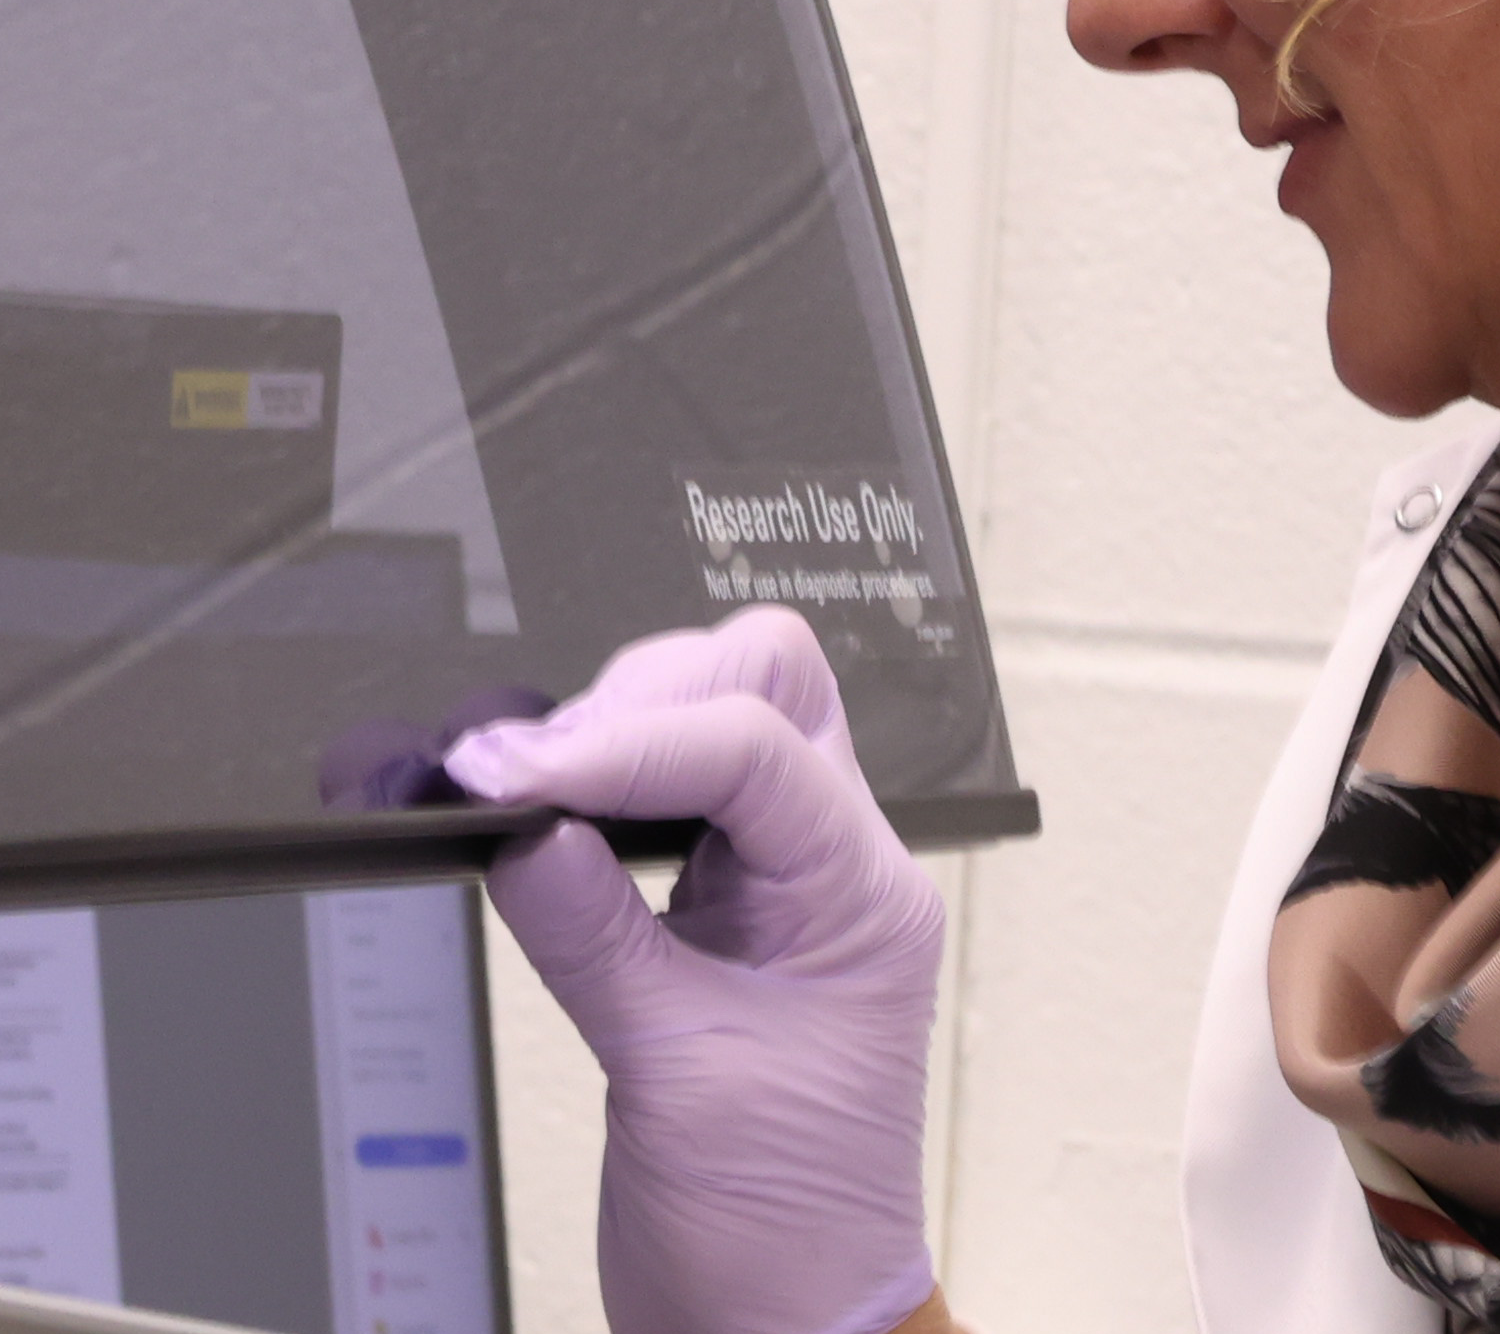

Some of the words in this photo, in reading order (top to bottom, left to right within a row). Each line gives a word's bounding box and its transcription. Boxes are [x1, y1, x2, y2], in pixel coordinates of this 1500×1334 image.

[685, 480, 809, 543] Research
[806, 481, 860, 543] Use
[860, 480, 924, 555] Only.
[702, 565, 733, 600] Not
[731, 569, 751, 600] for
[753, 576, 779, 600] use
[778, 570, 794, 599] in
[795, 569, 861, 607] diagnostic
